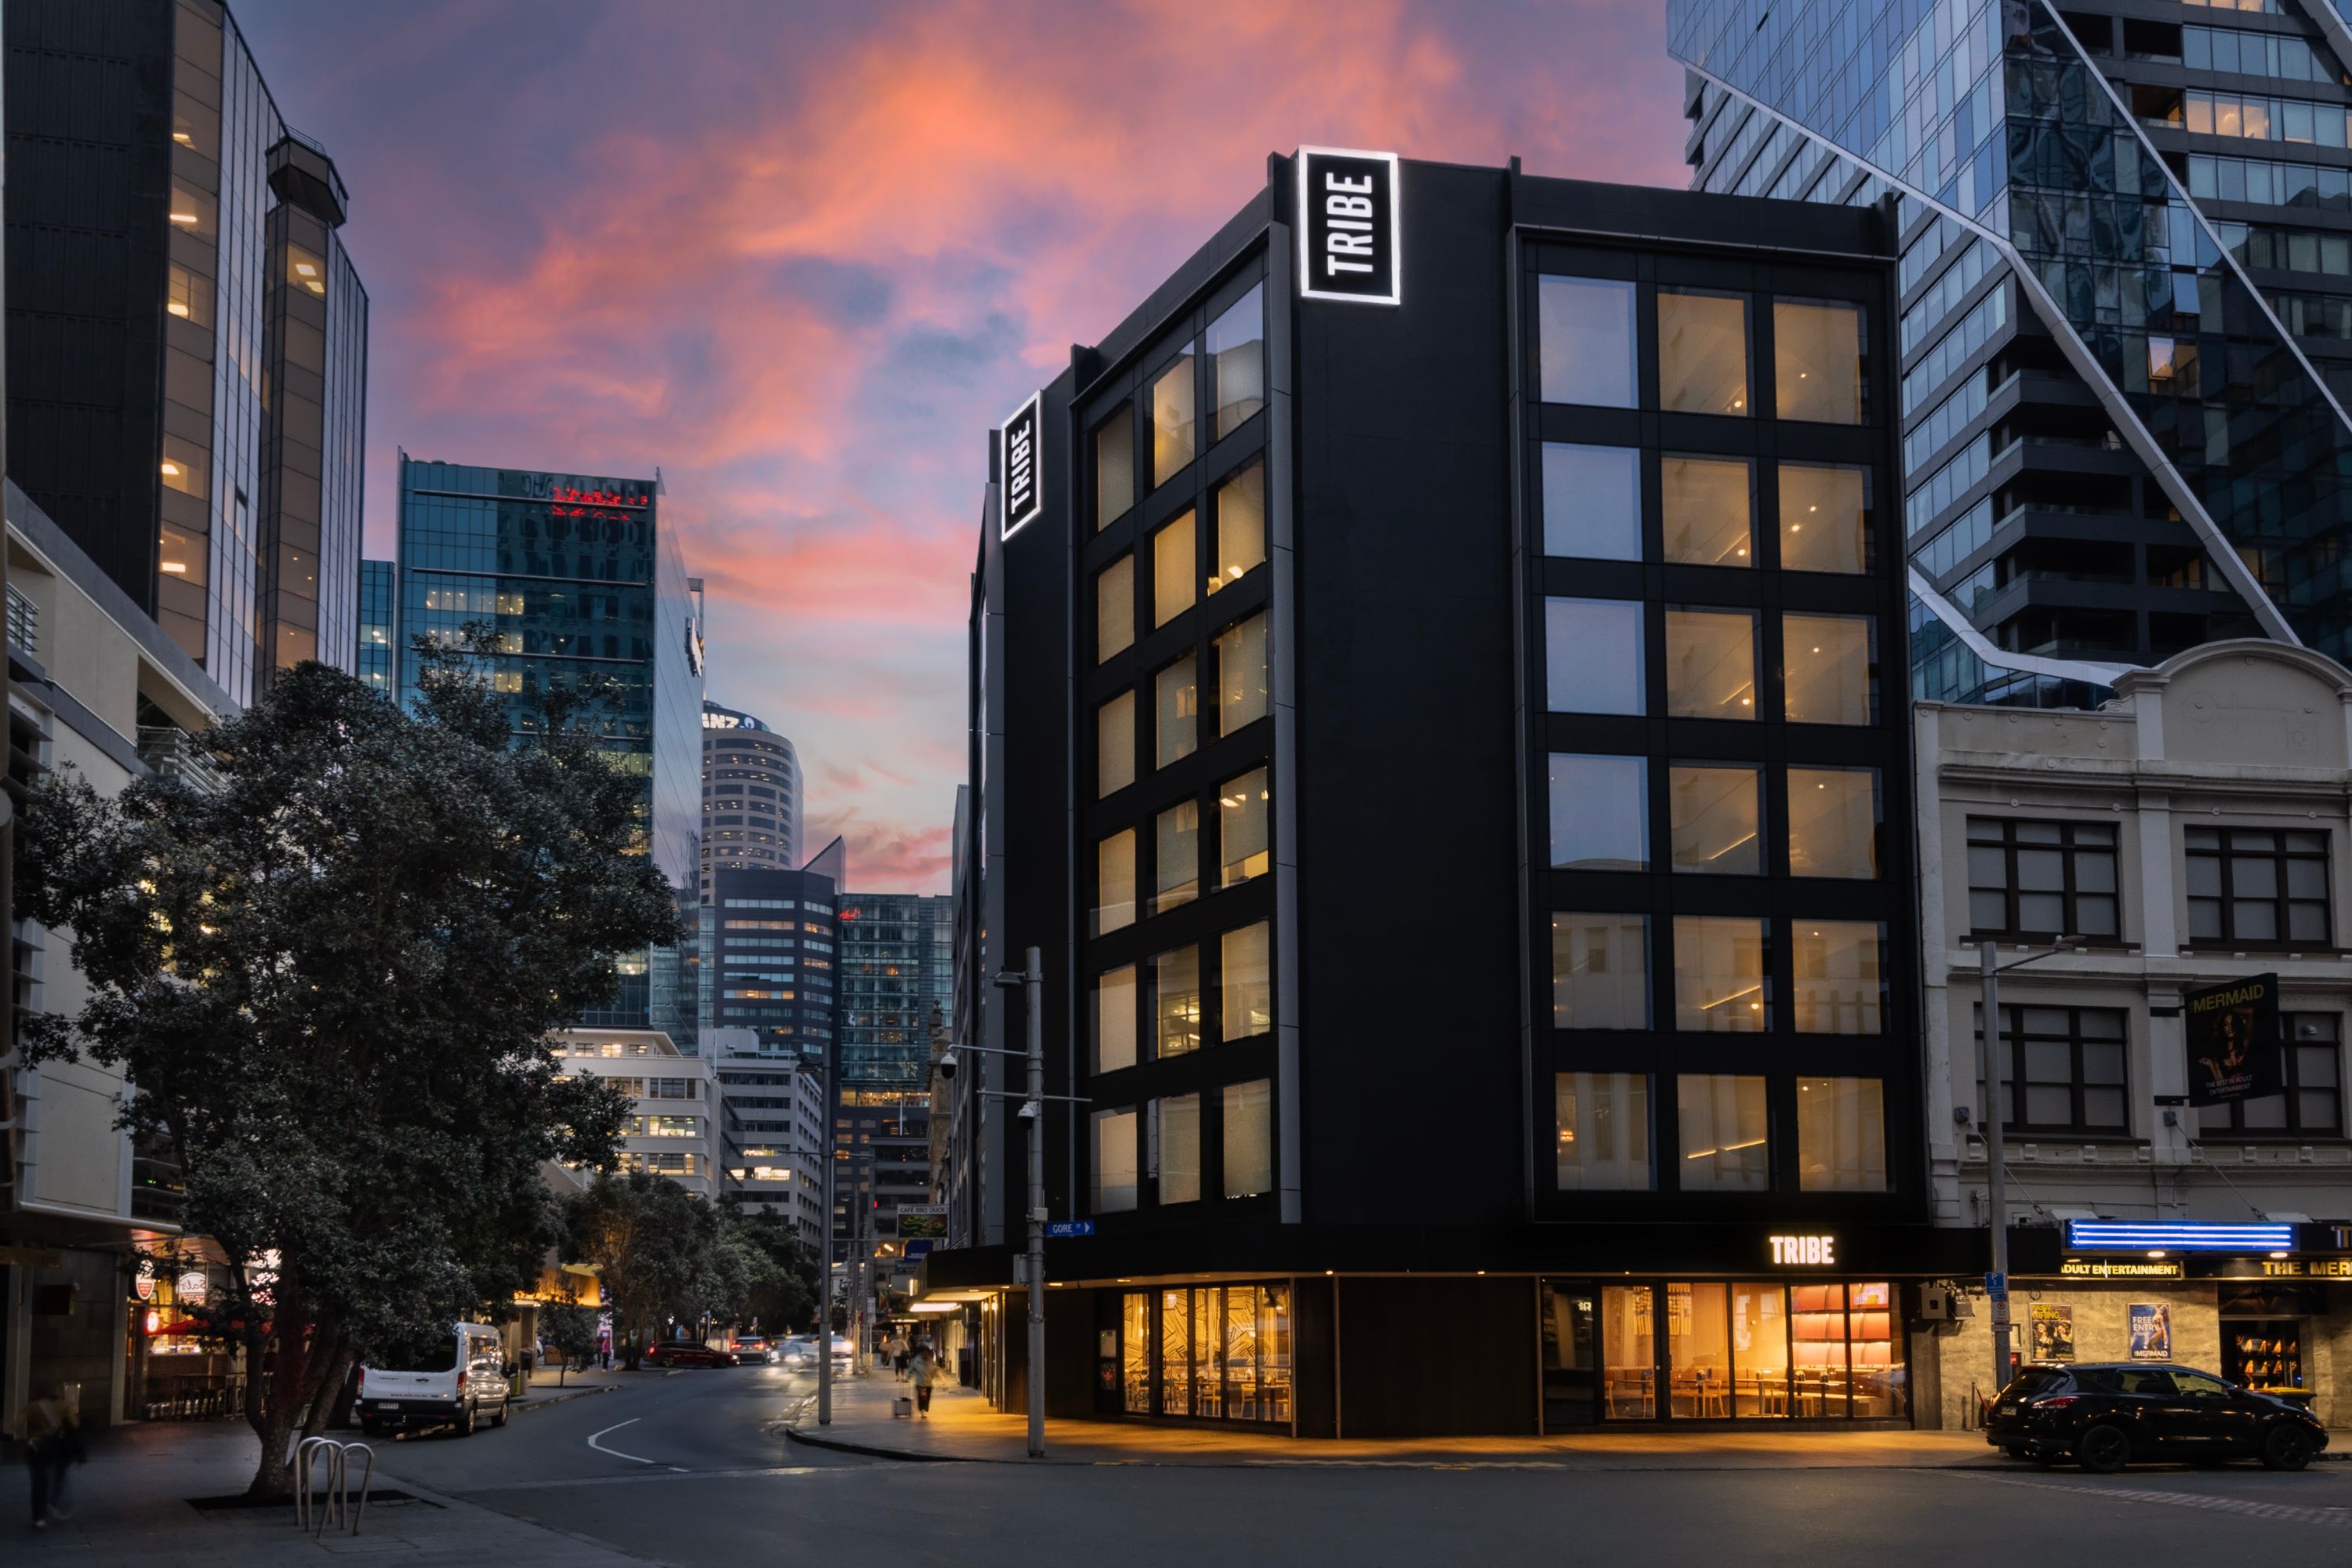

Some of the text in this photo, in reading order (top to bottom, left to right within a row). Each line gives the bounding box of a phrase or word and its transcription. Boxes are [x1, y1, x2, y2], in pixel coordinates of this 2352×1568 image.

[1326, 172, 1374, 276] TRIBE
[1011, 419, 1030, 514] TRIBE
[2193, 984, 2265, 1014] MERMAID
[1053, 1223, 1073, 1233] GORE
[1769, 1236, 1835, 1264] TRIBE
[2092, 1265, 2178, 1275] ENTERTAINMENT
[2262, 1261, 2352, 1276] THE MER
